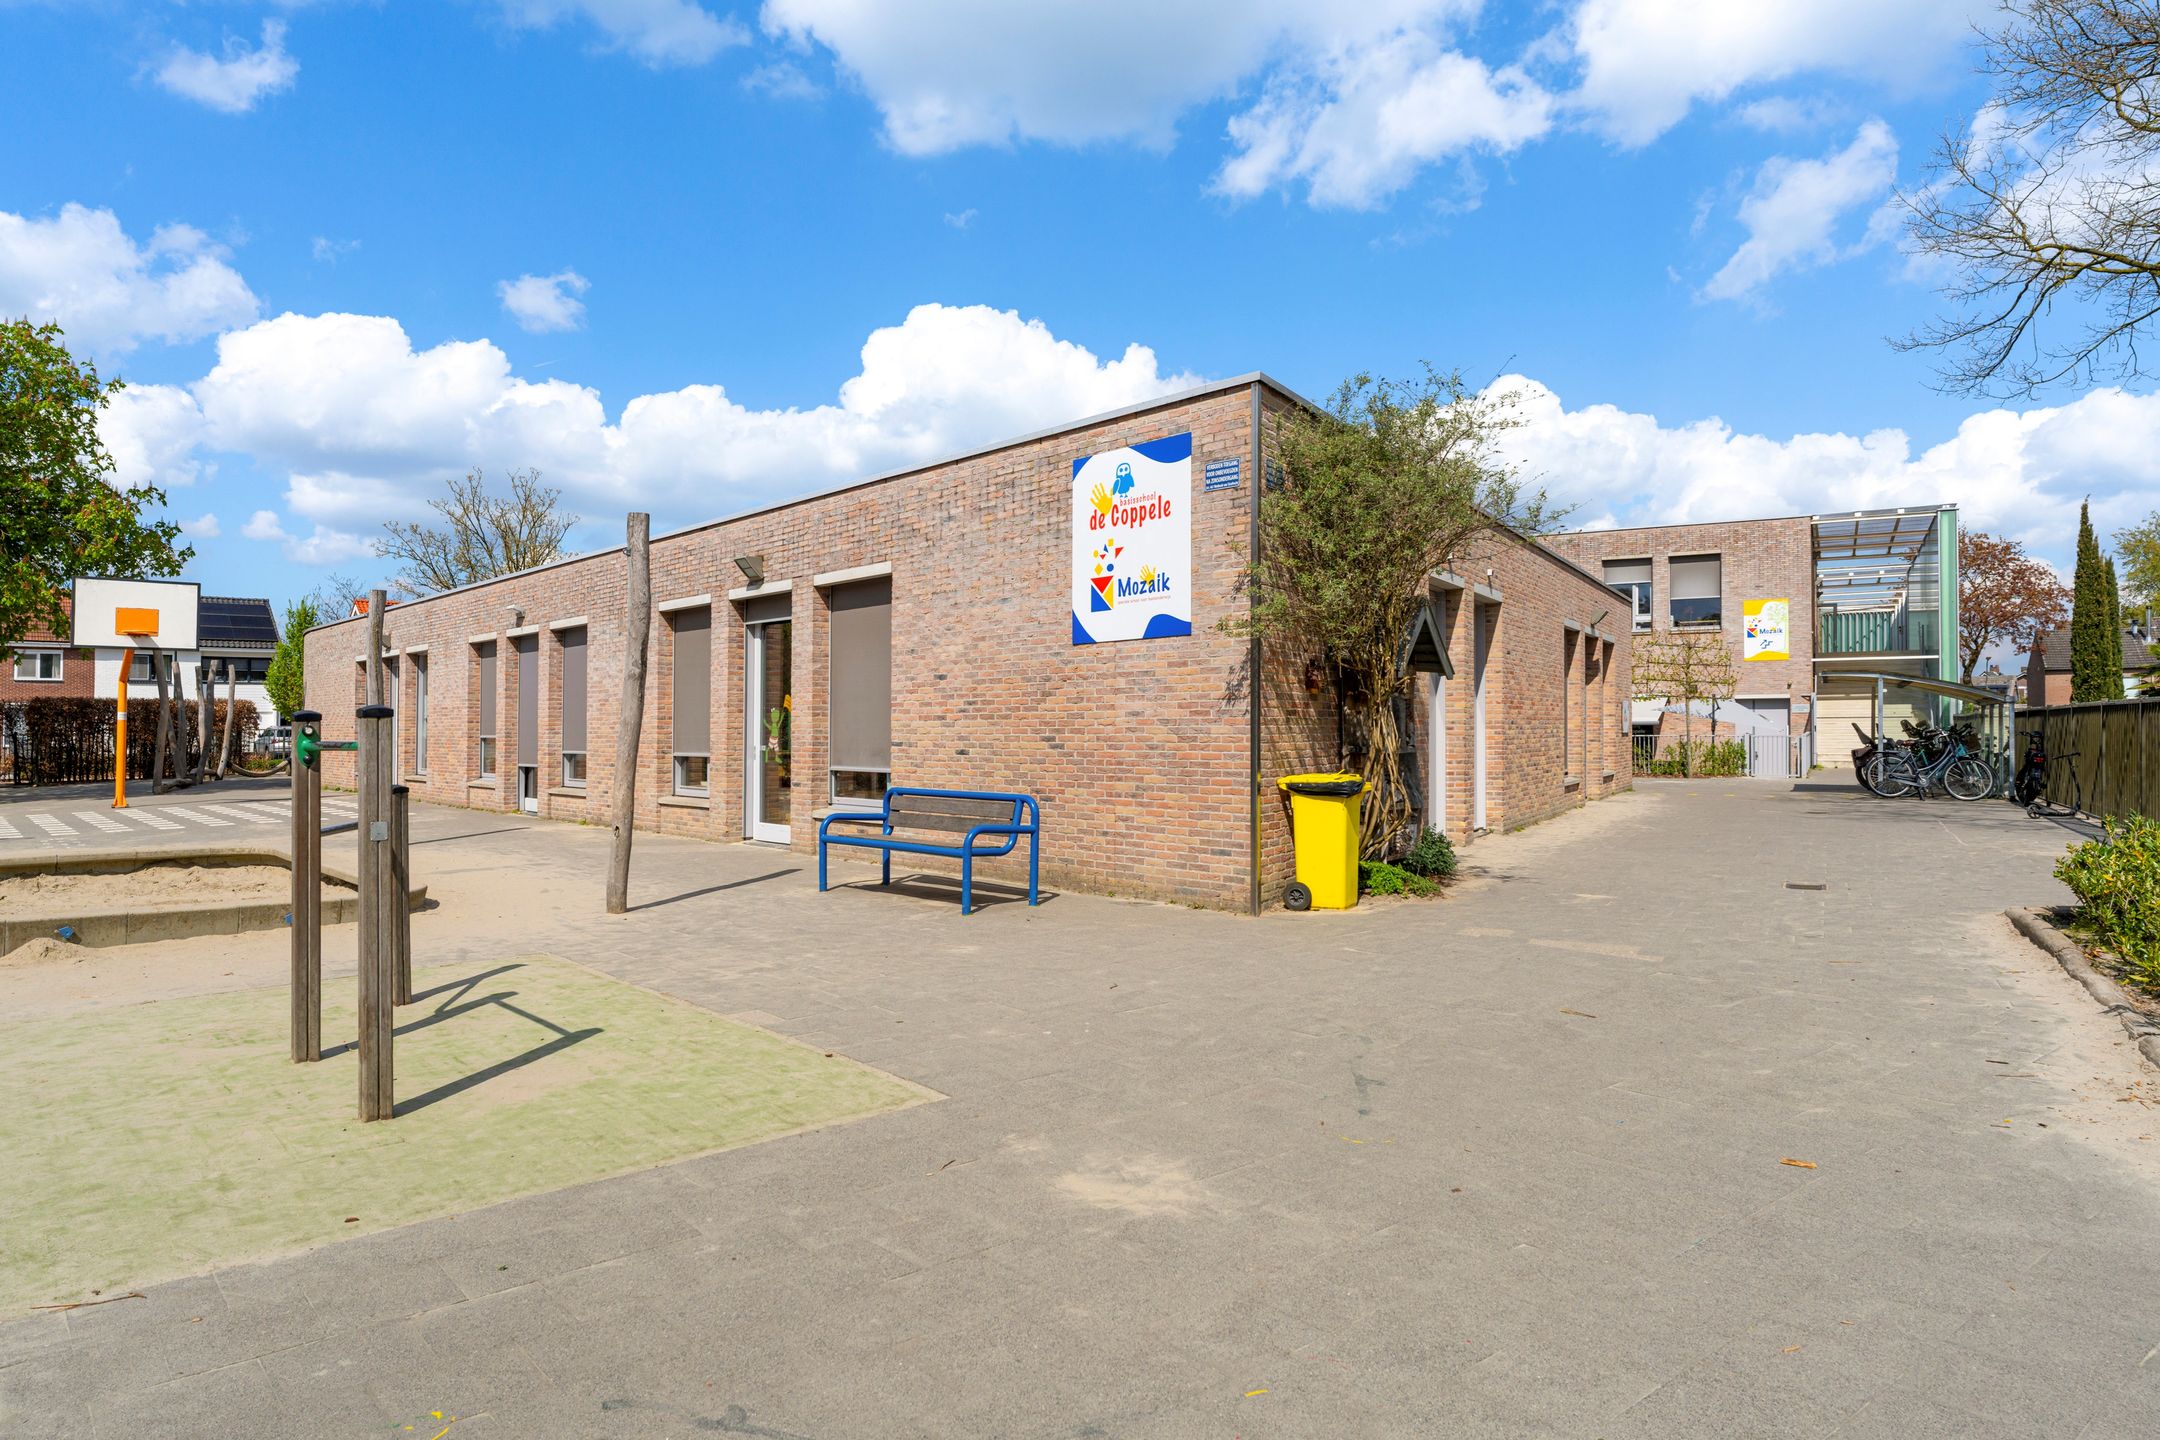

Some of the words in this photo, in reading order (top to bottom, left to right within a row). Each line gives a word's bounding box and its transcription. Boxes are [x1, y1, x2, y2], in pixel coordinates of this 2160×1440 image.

[1120, 491, 1156, 506] basisschool
[1090, 509, 1105, 530] de
[1111, 495, 1171, 529] Coppele
[1117, 572, 1170, 598] Mozaik
[1759, 627, 1783, 635] Mozaik
